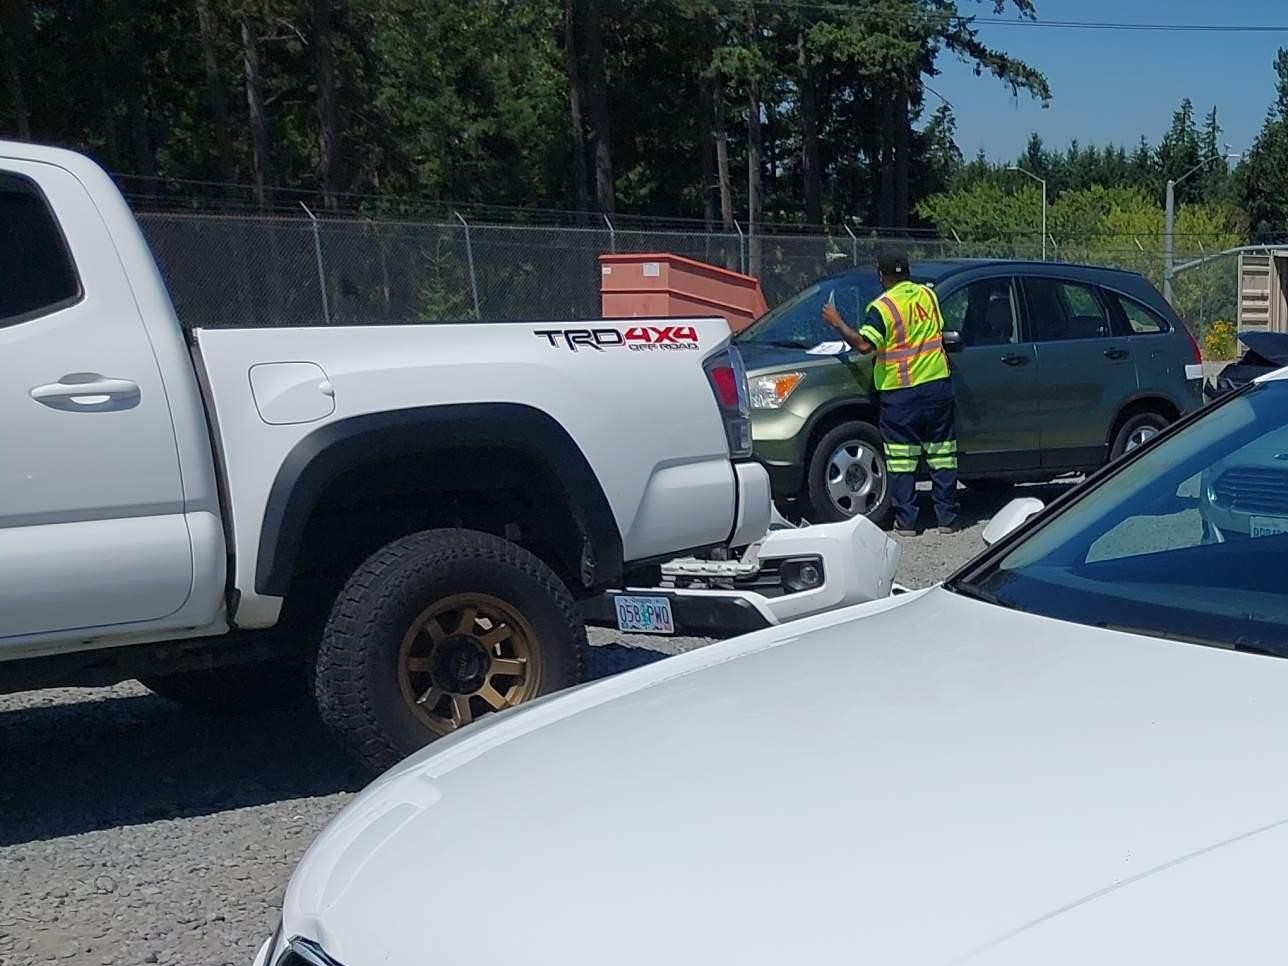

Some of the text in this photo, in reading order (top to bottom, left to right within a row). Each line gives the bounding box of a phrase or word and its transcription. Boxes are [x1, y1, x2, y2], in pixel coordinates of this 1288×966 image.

[534, 328, 625, 352] TRD
[629, 343, 699, 351] OFF ROAD
[620, 604, 641, 623] 058
